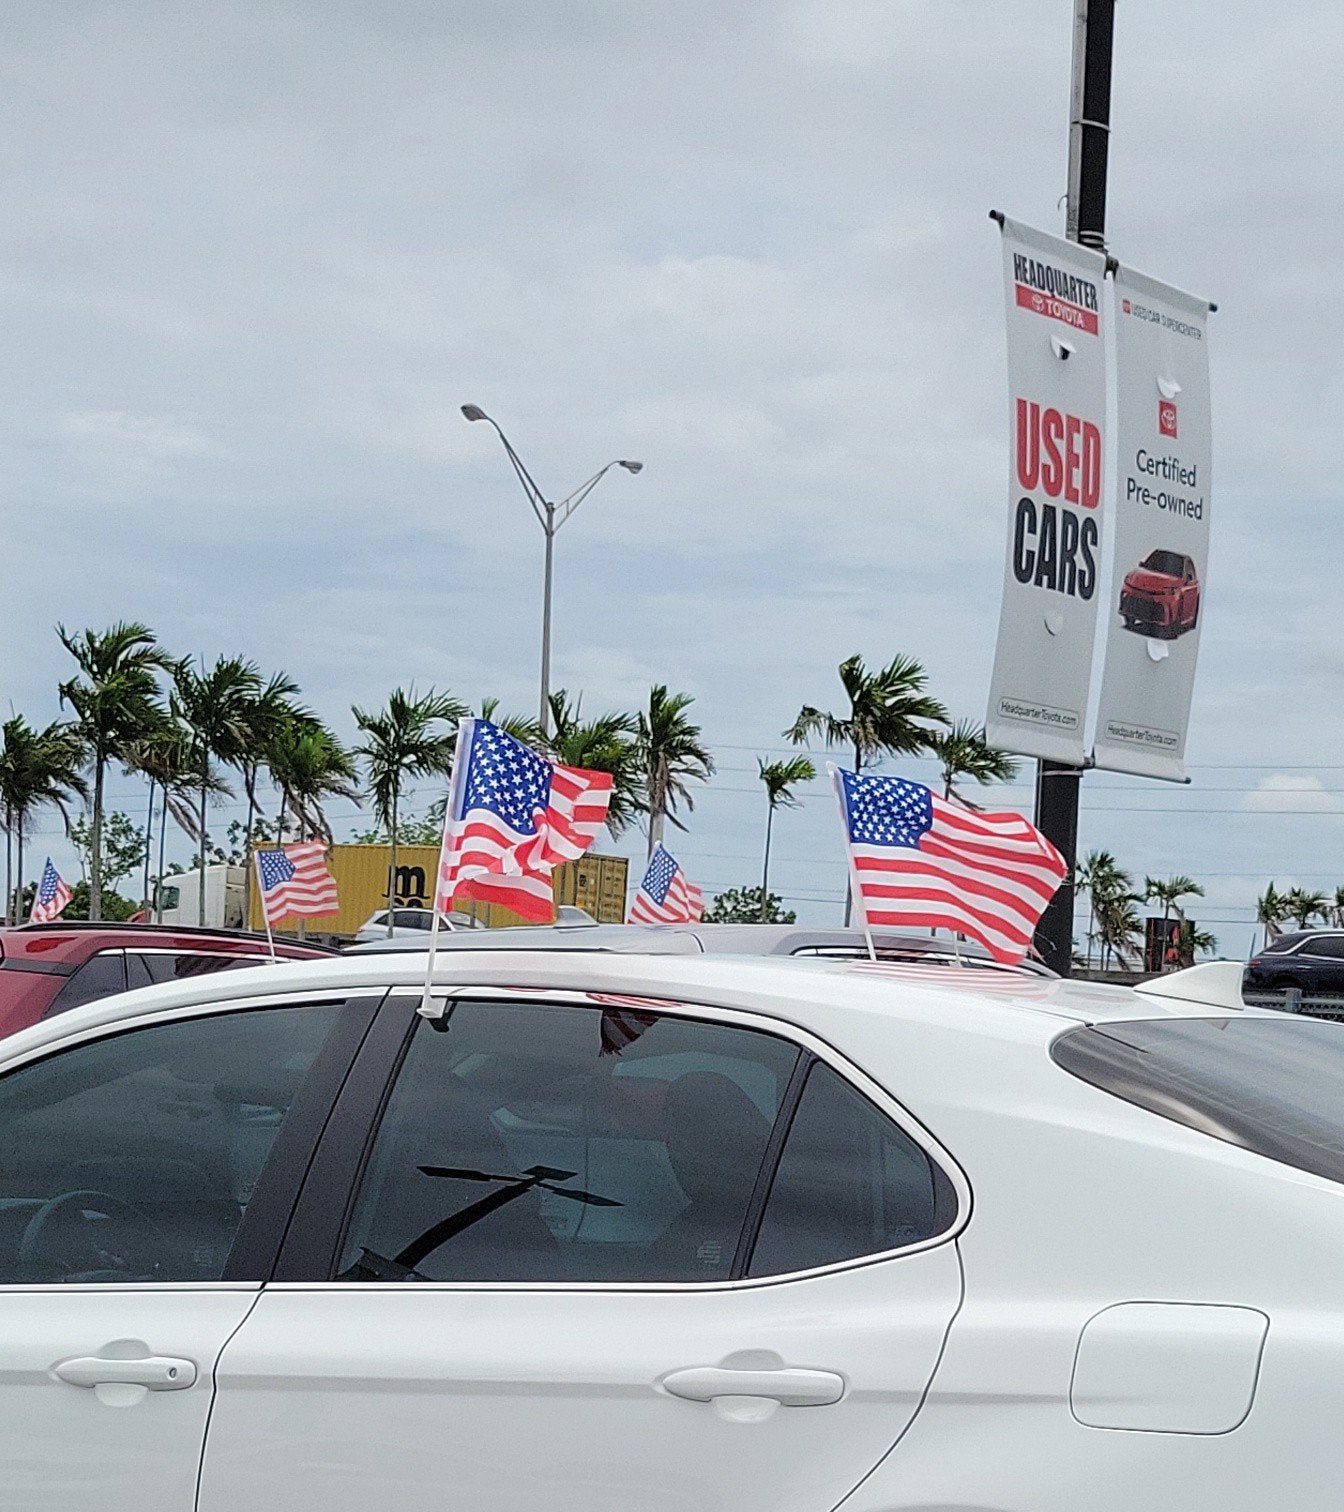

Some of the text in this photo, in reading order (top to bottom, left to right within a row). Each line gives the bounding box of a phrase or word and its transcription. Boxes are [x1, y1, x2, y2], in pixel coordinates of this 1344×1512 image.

[1013, 252, 1098, 312] HEADQUARTER
[1045, 299, 1085, 328] TOYOTA
[1016, 398, 1101, 510] USED
[1136, 449, 1197, 488] Certified
[1127, 477, 1203, 520] Pre-owned
[1013, 497, 1098, 601] CARS
